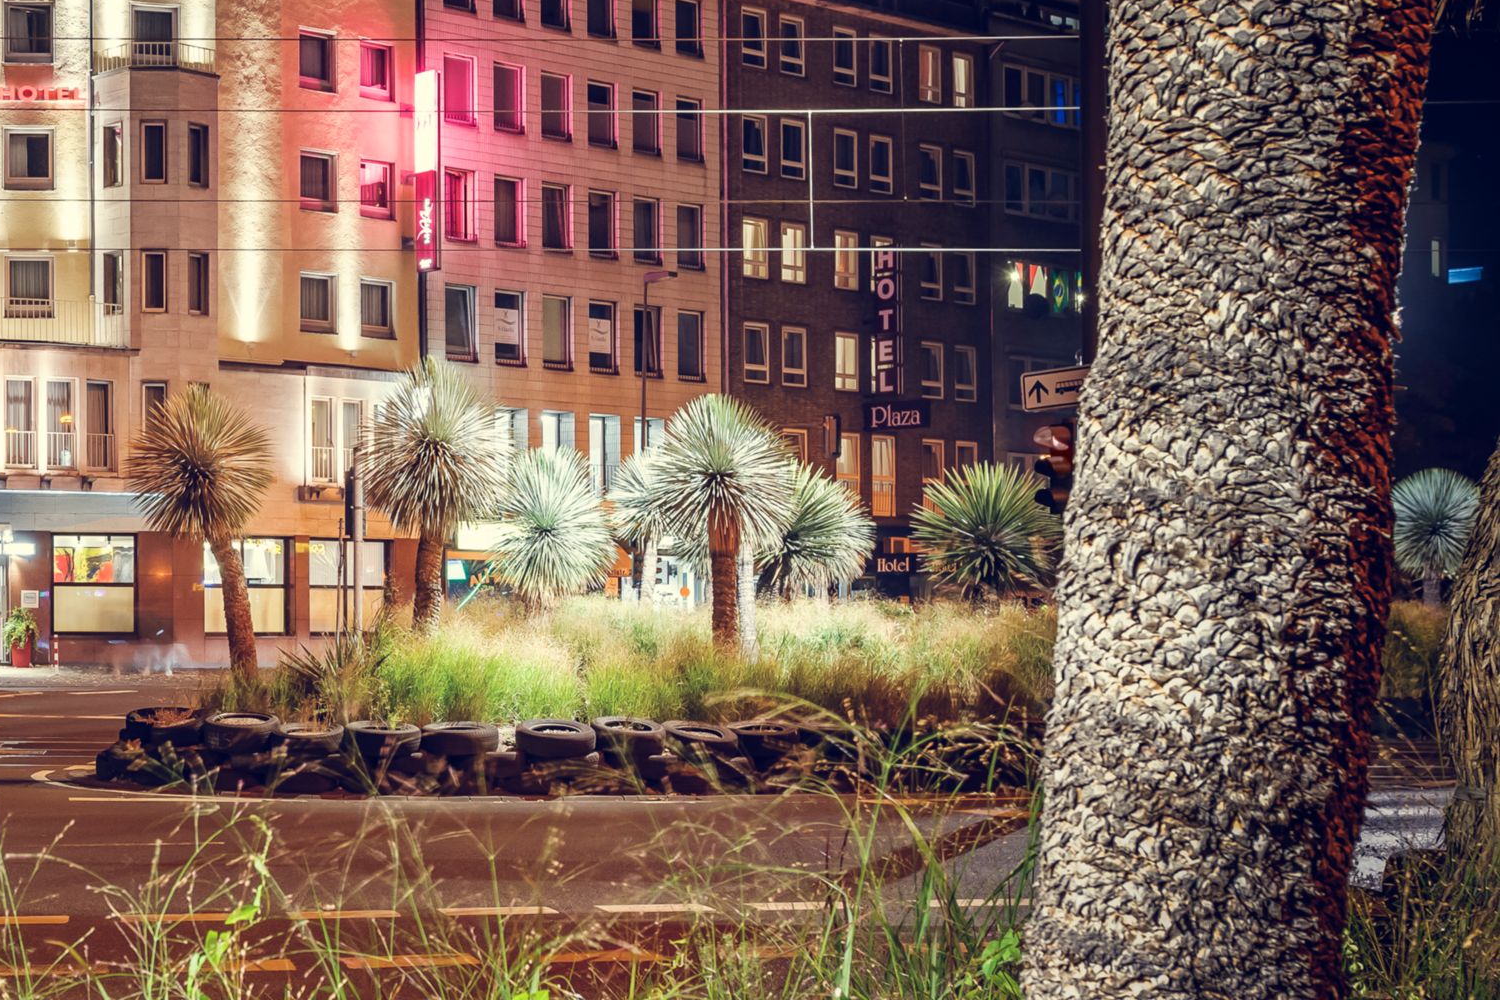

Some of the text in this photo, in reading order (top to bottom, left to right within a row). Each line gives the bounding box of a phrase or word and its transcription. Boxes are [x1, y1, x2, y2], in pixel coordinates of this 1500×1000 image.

[876, 249, 895, 393] HOTEL
[871, 405, 921, 428] Plaza
[877, 556, 909, 572] Hotel
